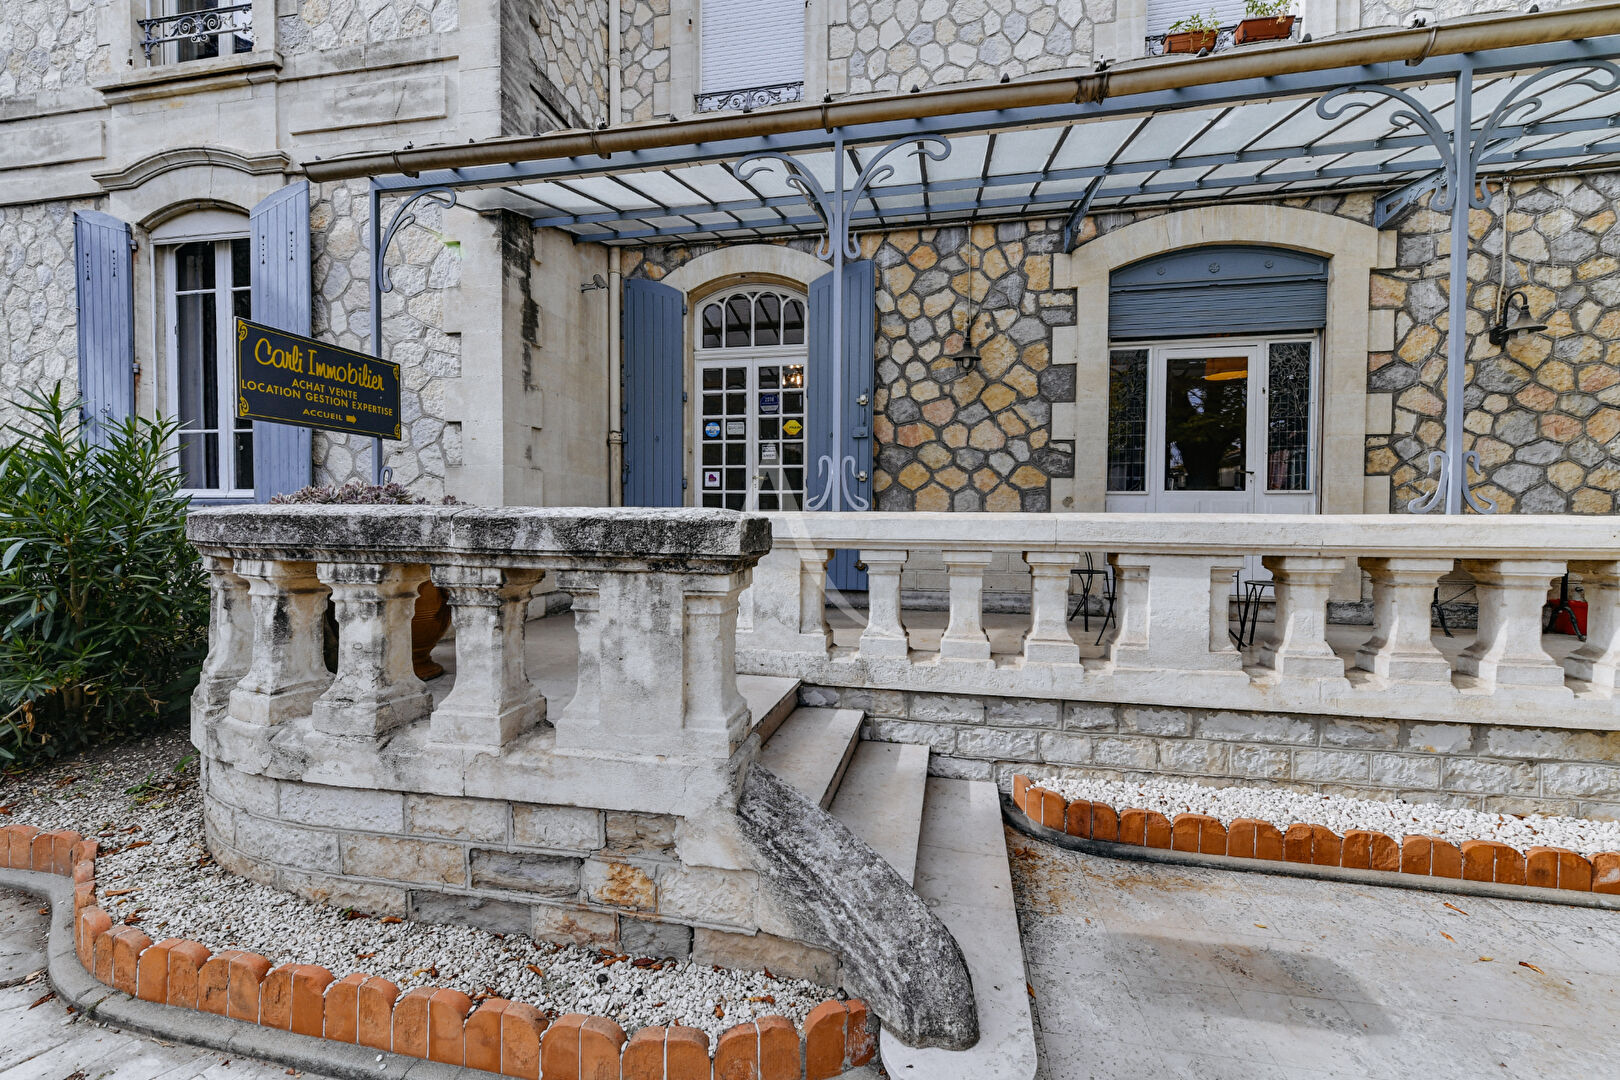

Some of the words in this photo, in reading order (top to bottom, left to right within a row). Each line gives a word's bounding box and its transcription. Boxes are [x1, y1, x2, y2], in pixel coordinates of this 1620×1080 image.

[254, 337, 303, 373] Carli
[307, 349, 385, 391] Immobilier
[241, 379, 301, 399] LOCATION
[305, 392, 348, 408] GESTION
[352, 401, 393, 416] EXPERTISE
[291, 378, 325, 393] ACHAT
[329, 386, 358, 400] VENTE
[302, 408, 343, 421] ACCUEIL
